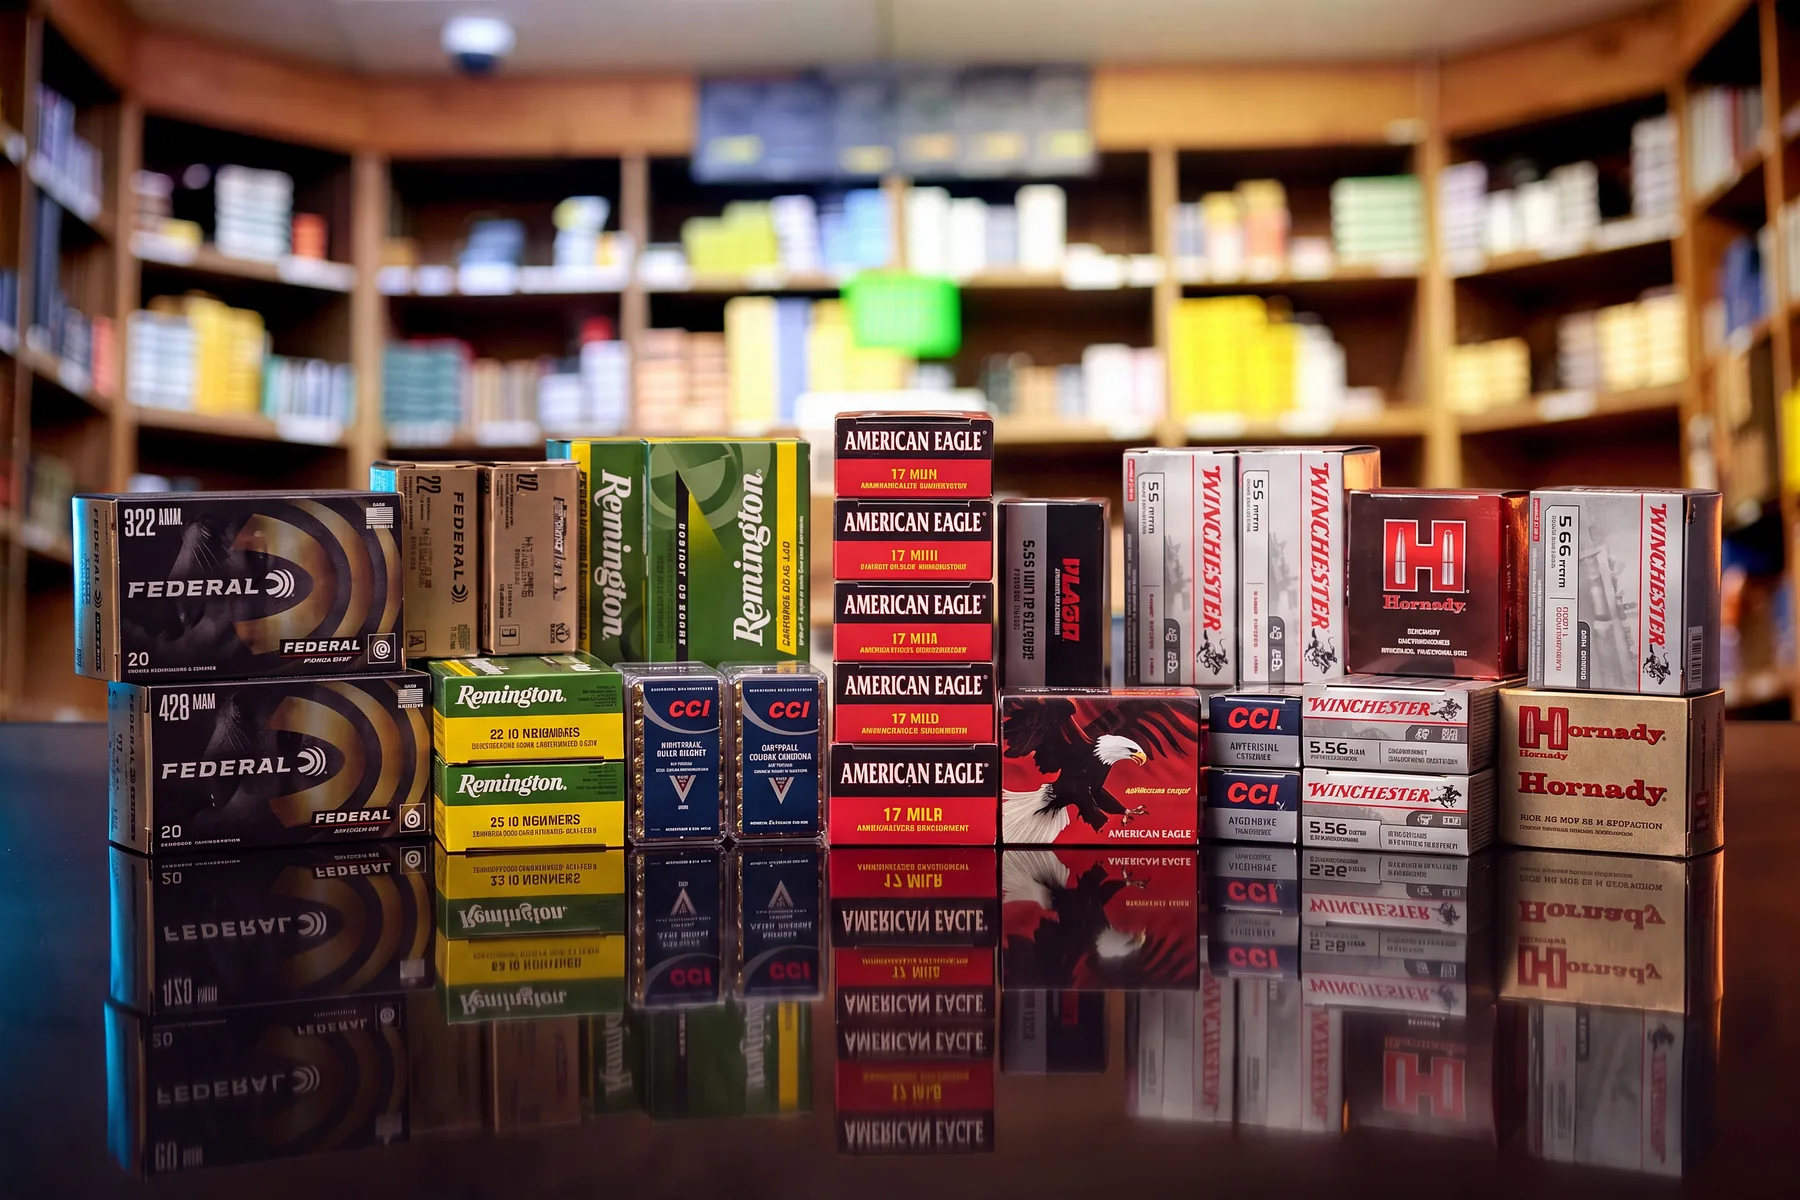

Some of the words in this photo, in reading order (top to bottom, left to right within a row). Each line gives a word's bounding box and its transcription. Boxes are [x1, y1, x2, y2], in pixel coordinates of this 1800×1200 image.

[844, 431, 930, 451] AMERICAN
[934, 431, 982, 451] EAGLE
[891, 468, 906, 480] 17
[416, 475, 441, 494] 22
[124, 508, 156, 537] 322
[844, 512, 930, 532] AMERICAN
[934, 512, 982, 532] EAGLE
[453, 491, 464, 581] FEDERAL
[1310, 462, 1330, 629] WINCHESTER
[594, 469, 632, 641] Remington
[891, 549, 905, 561] 17
[1202, 465, 1222, 632] WINCHESTER
[733, 472, 771, 646] Remington
[1649, 503, 1668, 649] WINCHESTER
[128, 578, 259, 598] FEDERAL
[844, 595, 930, 615] AMERICAN
[934, 595, 982, 615] EAGLE
[1382, 594, 1467, 614] Hornady
[283, 640, 361, 653] FEDERAL
[892, 632, 906, 644] 17
[128, 652, 149, 667] 20
[844, 675, 930, 695] AMERICAN
[934, 675, 983, 695] EAGLE
[455, 684, 567, 709] Remington
[1308, 696, 1431, 716] WINCHESTER
[159, 693, 190, 721] 428
[669, 699, 711, 718] CCI
[769, 701, 810, 719] CCI
[892, 713, 906, 724] 17
[1228, 707, 1280, 730] CCI
[490, 729, 504, 740] 22
[1310, 741, 1348, 755] 5.56
[161, 757, 291, 780] FEDERAL
[840, 763, 930, 784] AMERICAN
[935, 763, 984, 784] EAGLE
[456, 773, 567, 798] Remington
[1227, 782, 1279, 805] CCI
[1308, 782, 1431, 803] WINCHESTER
[1518, 771, 1668, 806] Hornady
[315, 809, 391, 824] FEDERAL
[490, 817, 504, 828] 25
[883, 807, 902, 822] 17
[161, 825, 182, 839] 20
[1108, 829, 1160, 839] AMERICAN
[1162, 829, 1191, 839] EAGLE
[1310, 821, 1347, 835] 5.56
